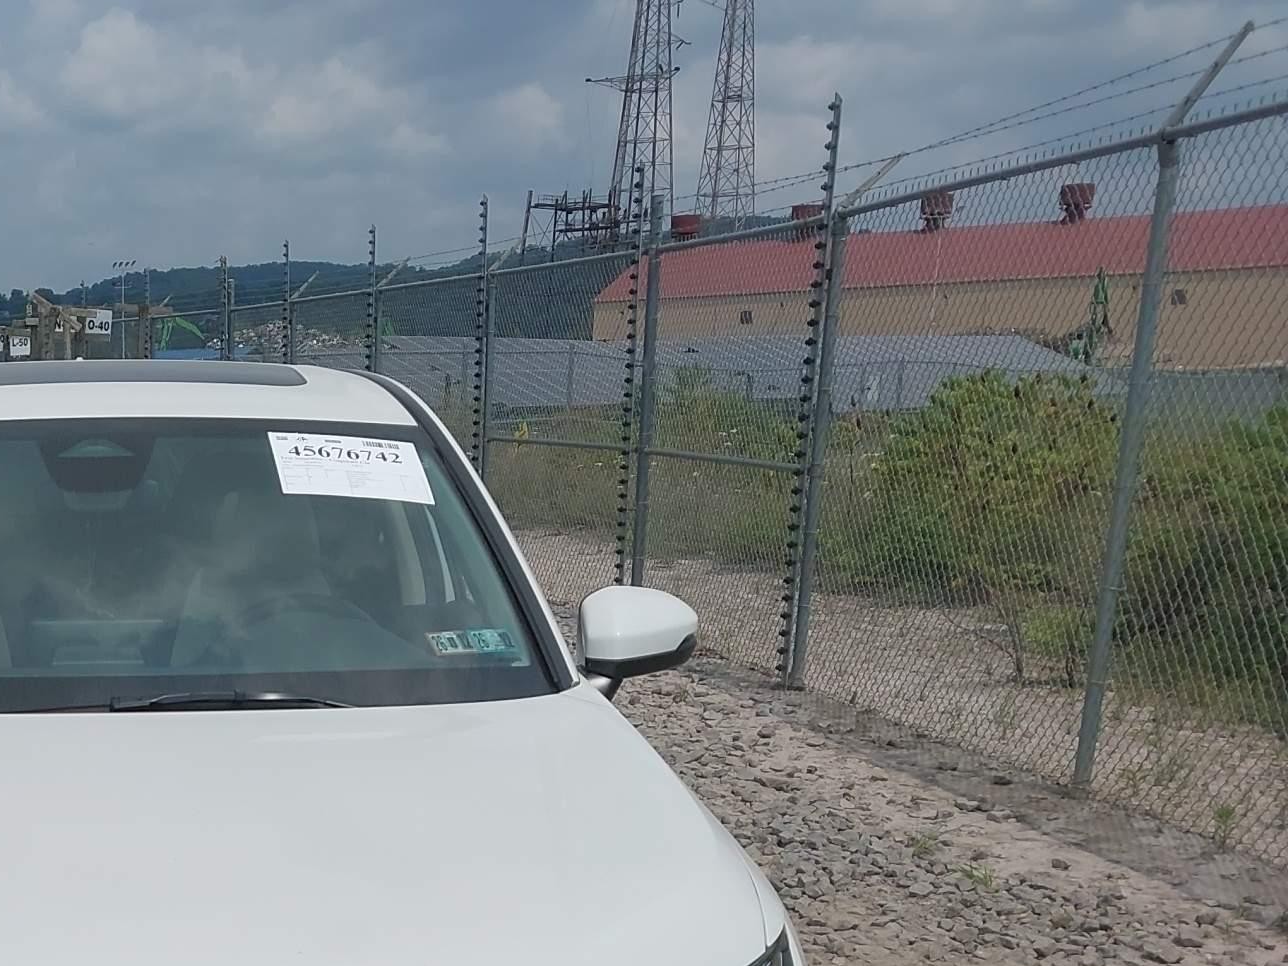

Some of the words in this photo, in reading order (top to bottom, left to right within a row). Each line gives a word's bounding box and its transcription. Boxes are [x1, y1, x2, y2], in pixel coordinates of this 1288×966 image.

[87, 320, 110, 331] O-40
[11, 338, 28, 347] L-50
[288, 445, 403, 464] 45676742
